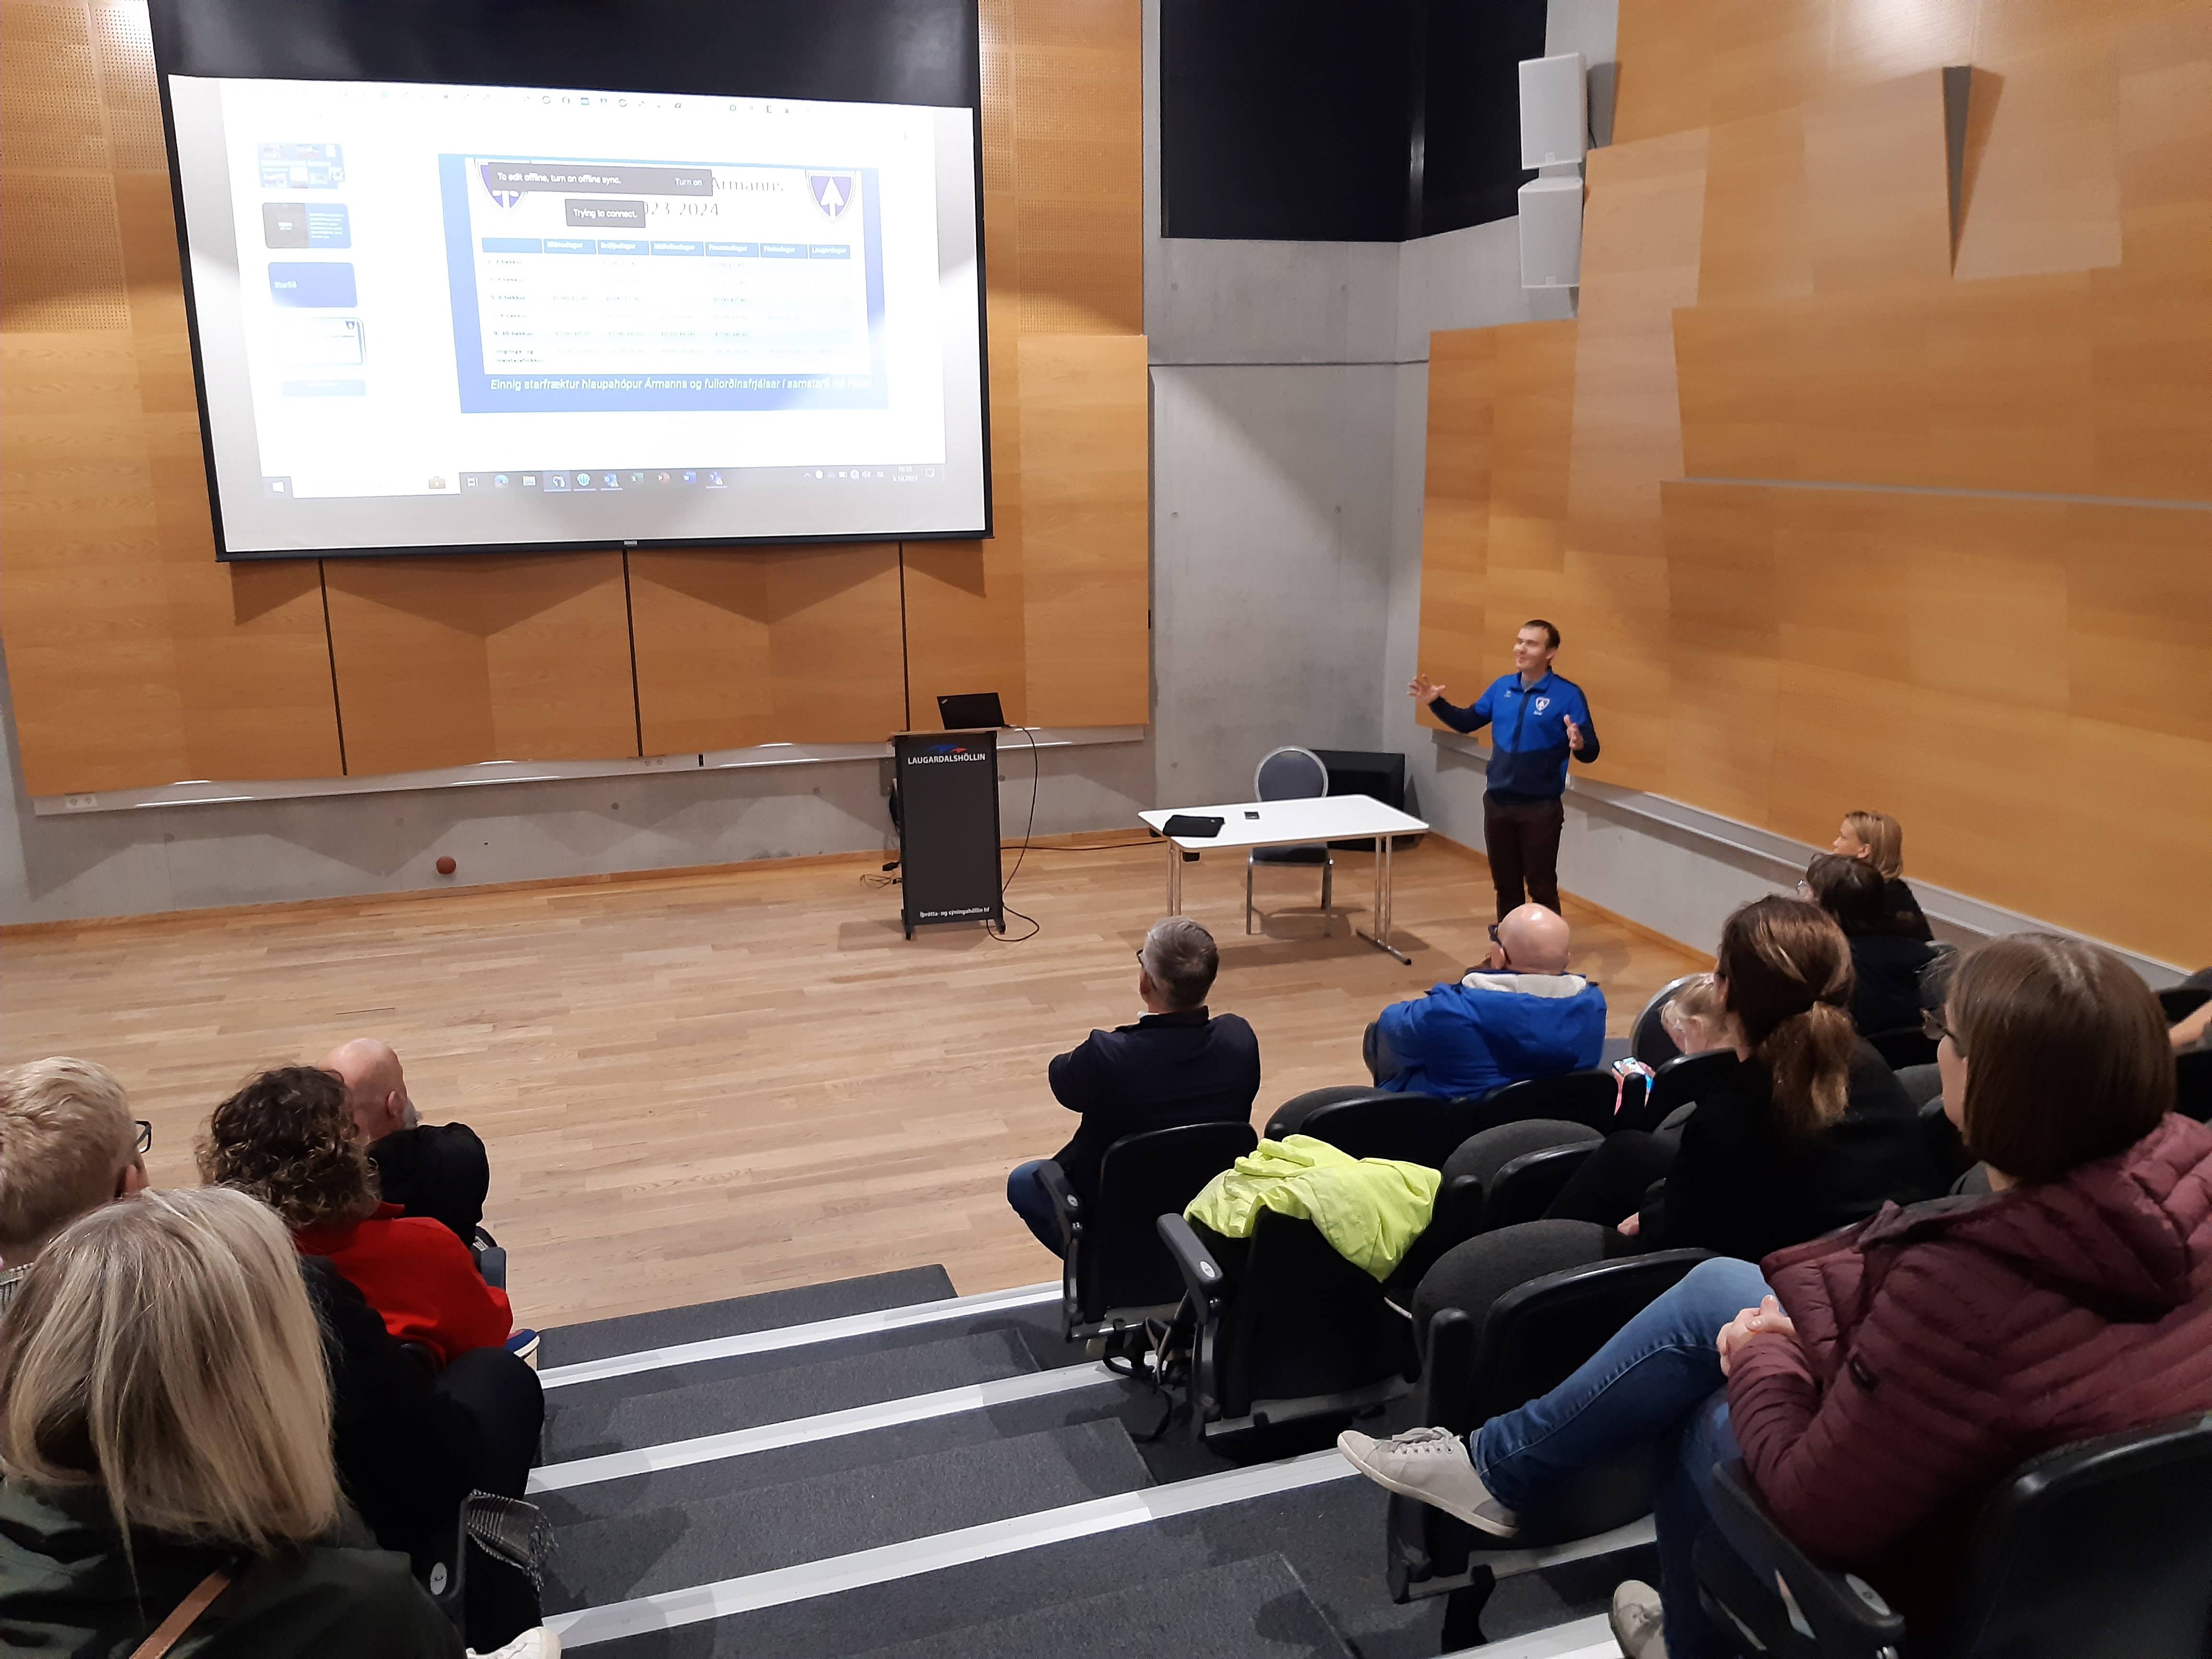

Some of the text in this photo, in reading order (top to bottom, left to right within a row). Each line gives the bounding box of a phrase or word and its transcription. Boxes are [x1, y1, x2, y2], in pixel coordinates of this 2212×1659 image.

[497, 172, 506, 181] To
[508, 173, 523, 182] edit
[524, 173, 549, 183] offline,
[551, 174, 565, 182] turn
[578, 174, 601, 184] offline
[602, 176, 621, 185] sync.
[675, 178, 691, 186] Turn
[573, 208, 637, 219] Trying to connect.
[491, 379, 521, 392] Einnig
[524, 379, 579, 390] starfræktur
[581, 378, 643, 391] hlaupahópur
[644, 377, 687, 389] Ármanns
[690, 380, 702, 391] og
[907, 752, 986, 765] LAUGARDALSHÖLLIN
